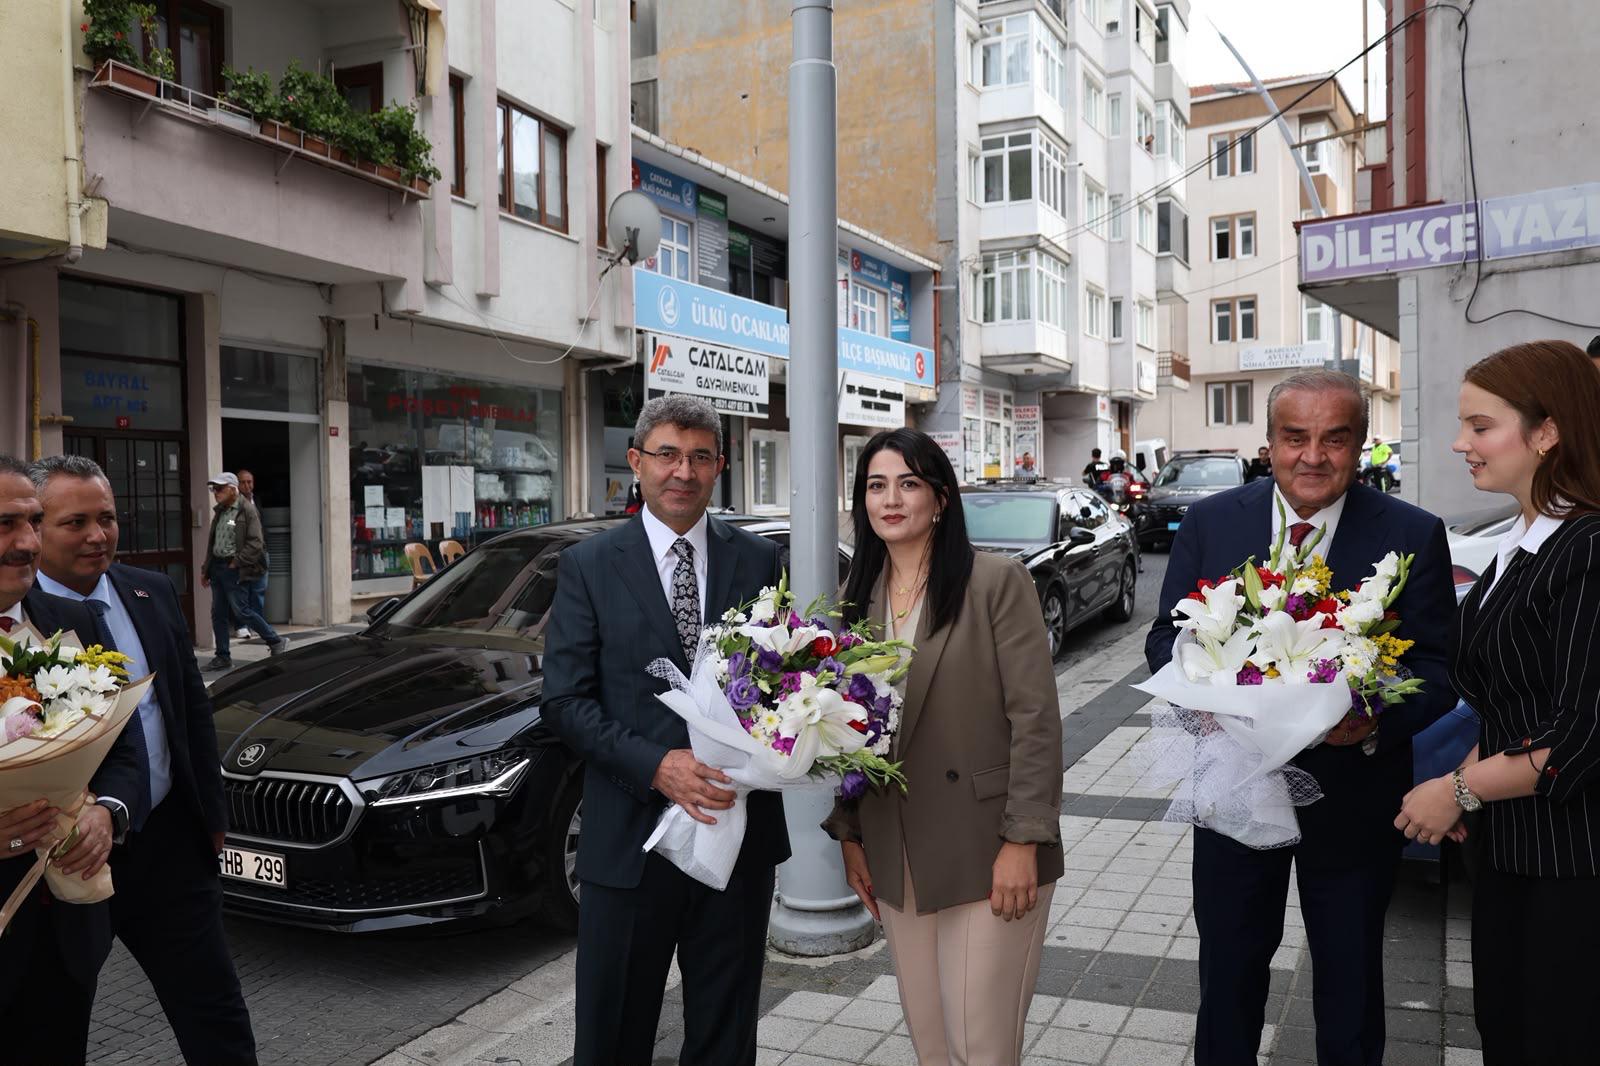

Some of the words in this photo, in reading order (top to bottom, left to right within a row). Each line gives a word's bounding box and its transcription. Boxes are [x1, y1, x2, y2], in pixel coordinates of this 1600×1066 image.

[1305, 213, 1476, 273] DİLEKÇE
[691, 297, 727, 331] ÜLKÜ
[841, 337, 862, 366] İLÇE
[863, 346, 910, 372] BAŞKANLIĞI
[1267, 352, 1302, 362] AVUKAT
[696, 376, 760, 396] GAYRİMENKUL
[254, 855, 283, 883] 299
